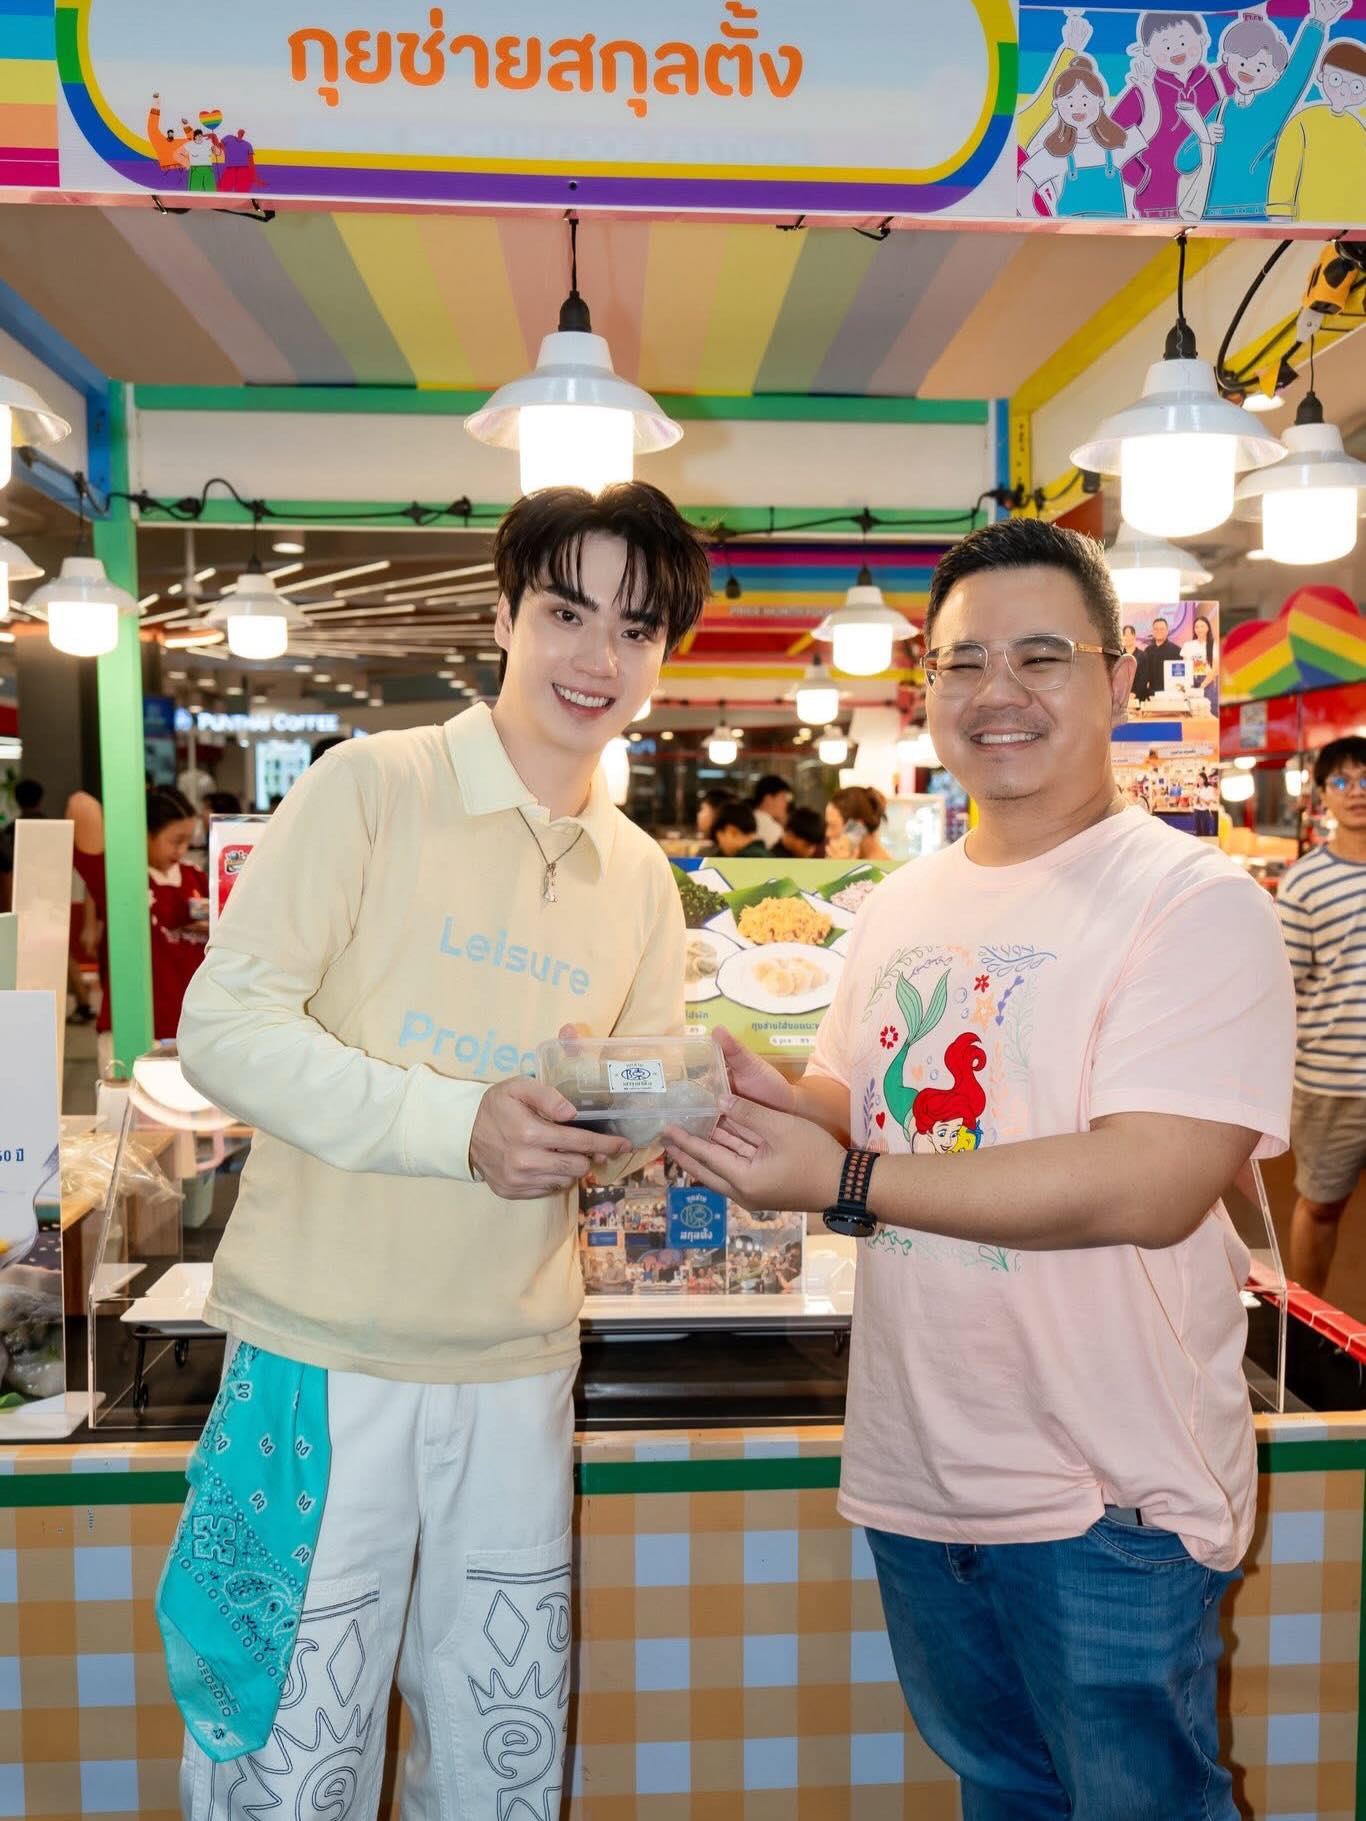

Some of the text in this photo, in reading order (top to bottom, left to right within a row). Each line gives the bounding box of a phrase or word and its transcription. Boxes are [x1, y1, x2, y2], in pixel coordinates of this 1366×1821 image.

[287, 1, 804, 119] กุยช่ายสกุลตั้ง
[272, 712, 339, 732] COFFEE
[439, 916, 590, 994] Leisure
[398, 1010, 537, 1078] Projec
